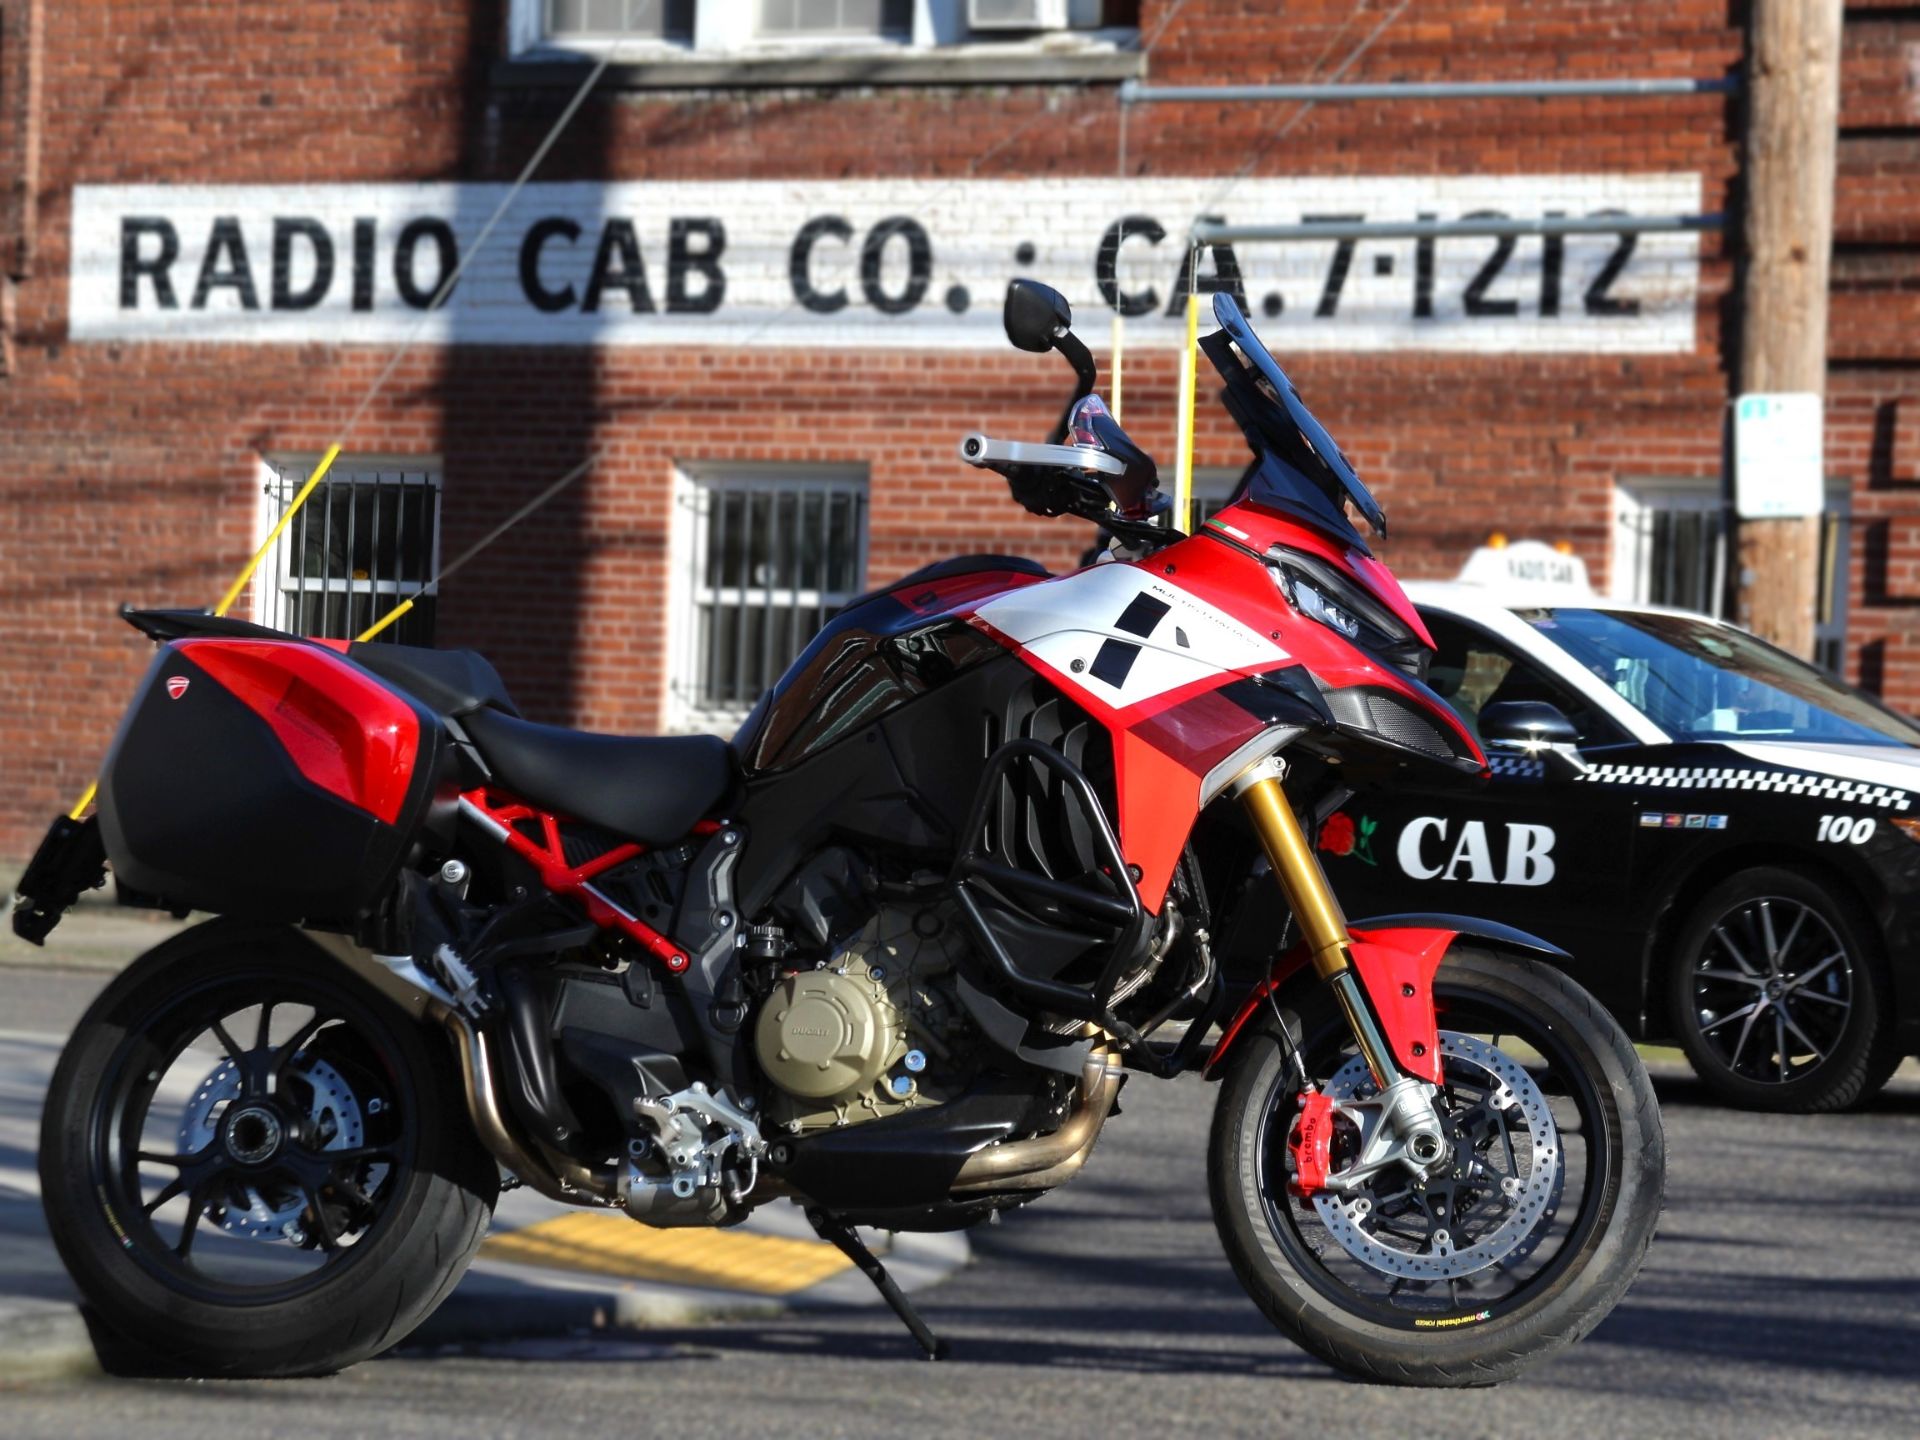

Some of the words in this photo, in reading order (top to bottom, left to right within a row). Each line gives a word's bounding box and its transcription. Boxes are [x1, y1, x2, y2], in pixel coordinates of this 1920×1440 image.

[118, 215, 459, 313] RADIO
[519, 216, 728, 314] CAB
[789, 214, 971, 315] CO.
[1397, 816, 1556, 887] CAB
[1816, 814, 1877, 845] 100
[1304, 1118, 1317, 1163] brembo
